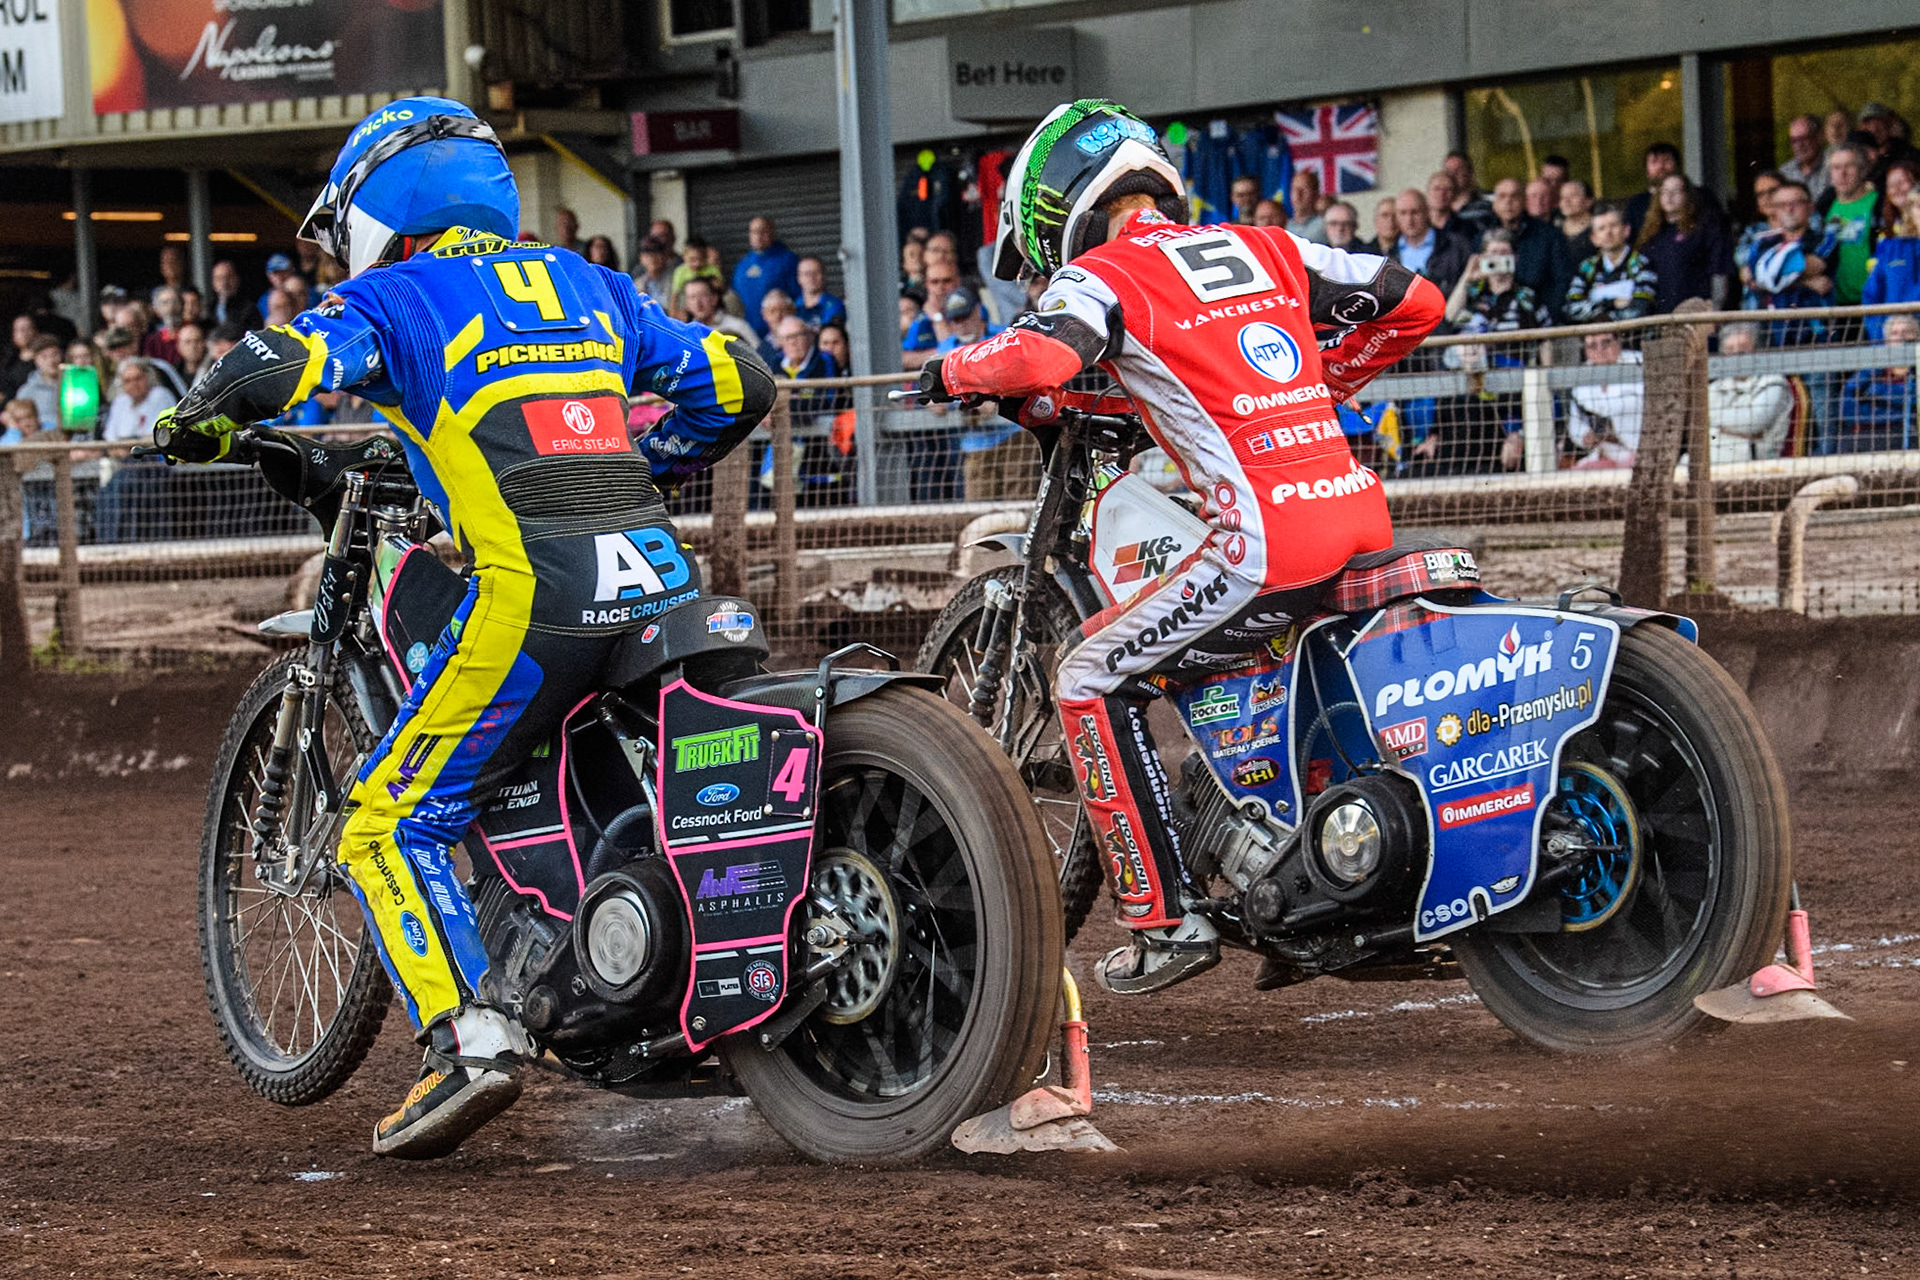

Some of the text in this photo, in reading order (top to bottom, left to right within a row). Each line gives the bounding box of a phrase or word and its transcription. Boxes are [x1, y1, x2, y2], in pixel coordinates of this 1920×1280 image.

[956, 61, 1066, 86] Bet Here
[352, 109, 414, 148] Picko
[1175, 239, 1254, 291] 5
[492, 259, 567, 321] 4
[476, 340, 622, 374] PICKERING
[675, 350, 692, 374] Ford
[1253, 341, 1288, 362] ATPI
[563, 403, 594, 432] MG
[552, 438, 620, 451] ERIC STEAD
[593, 527, 690, 602] AB
[582, 606, 630, 624] RACE
[1570, 632, 1596, 670] 5
[1191, 701, 1238, 719] ROCK OIL
[1385, 722, 1425, 748] AMD
[772, 747, 810, 803] 4
[1429, 737, 1550, 789] GARCAREK
[507, 793, 542, 809] ENZO
[700, 785, 736, 804] Ford
[1455, 791, 1532, 822] IMMERGAS
[671, 805, 762, 830] Cessnock Ford
[697, 892, 784, 912] ASPHALTS
[403, 914, 426, 952] Ford
[752, 971, 771, 988] STS
